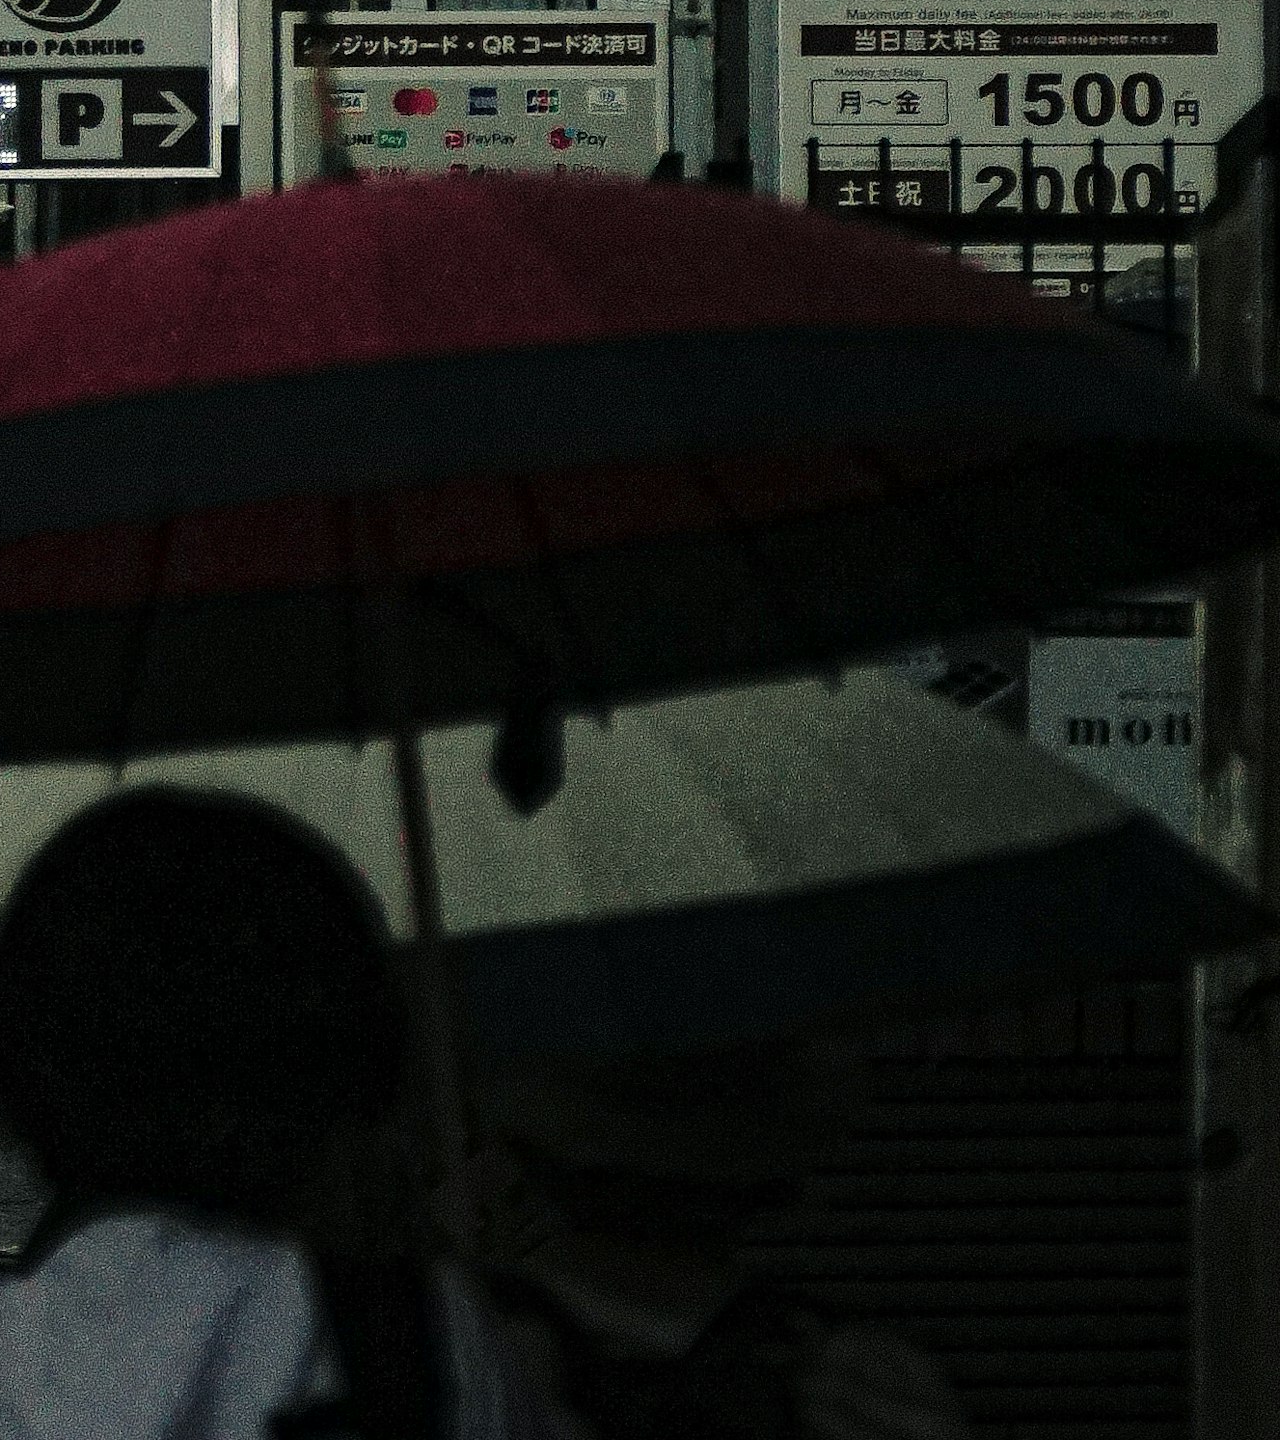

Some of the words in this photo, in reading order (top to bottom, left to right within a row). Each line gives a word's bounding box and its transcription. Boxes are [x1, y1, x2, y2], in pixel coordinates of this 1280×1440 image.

[44, 38, 145, 56] PARKING
[853, 29, 1002, 54] 当日最大料金
[978, 71, 1165, 127] 1500
[57, 92, 105, 146] P
[466, 131, 517, 146] PayPay
